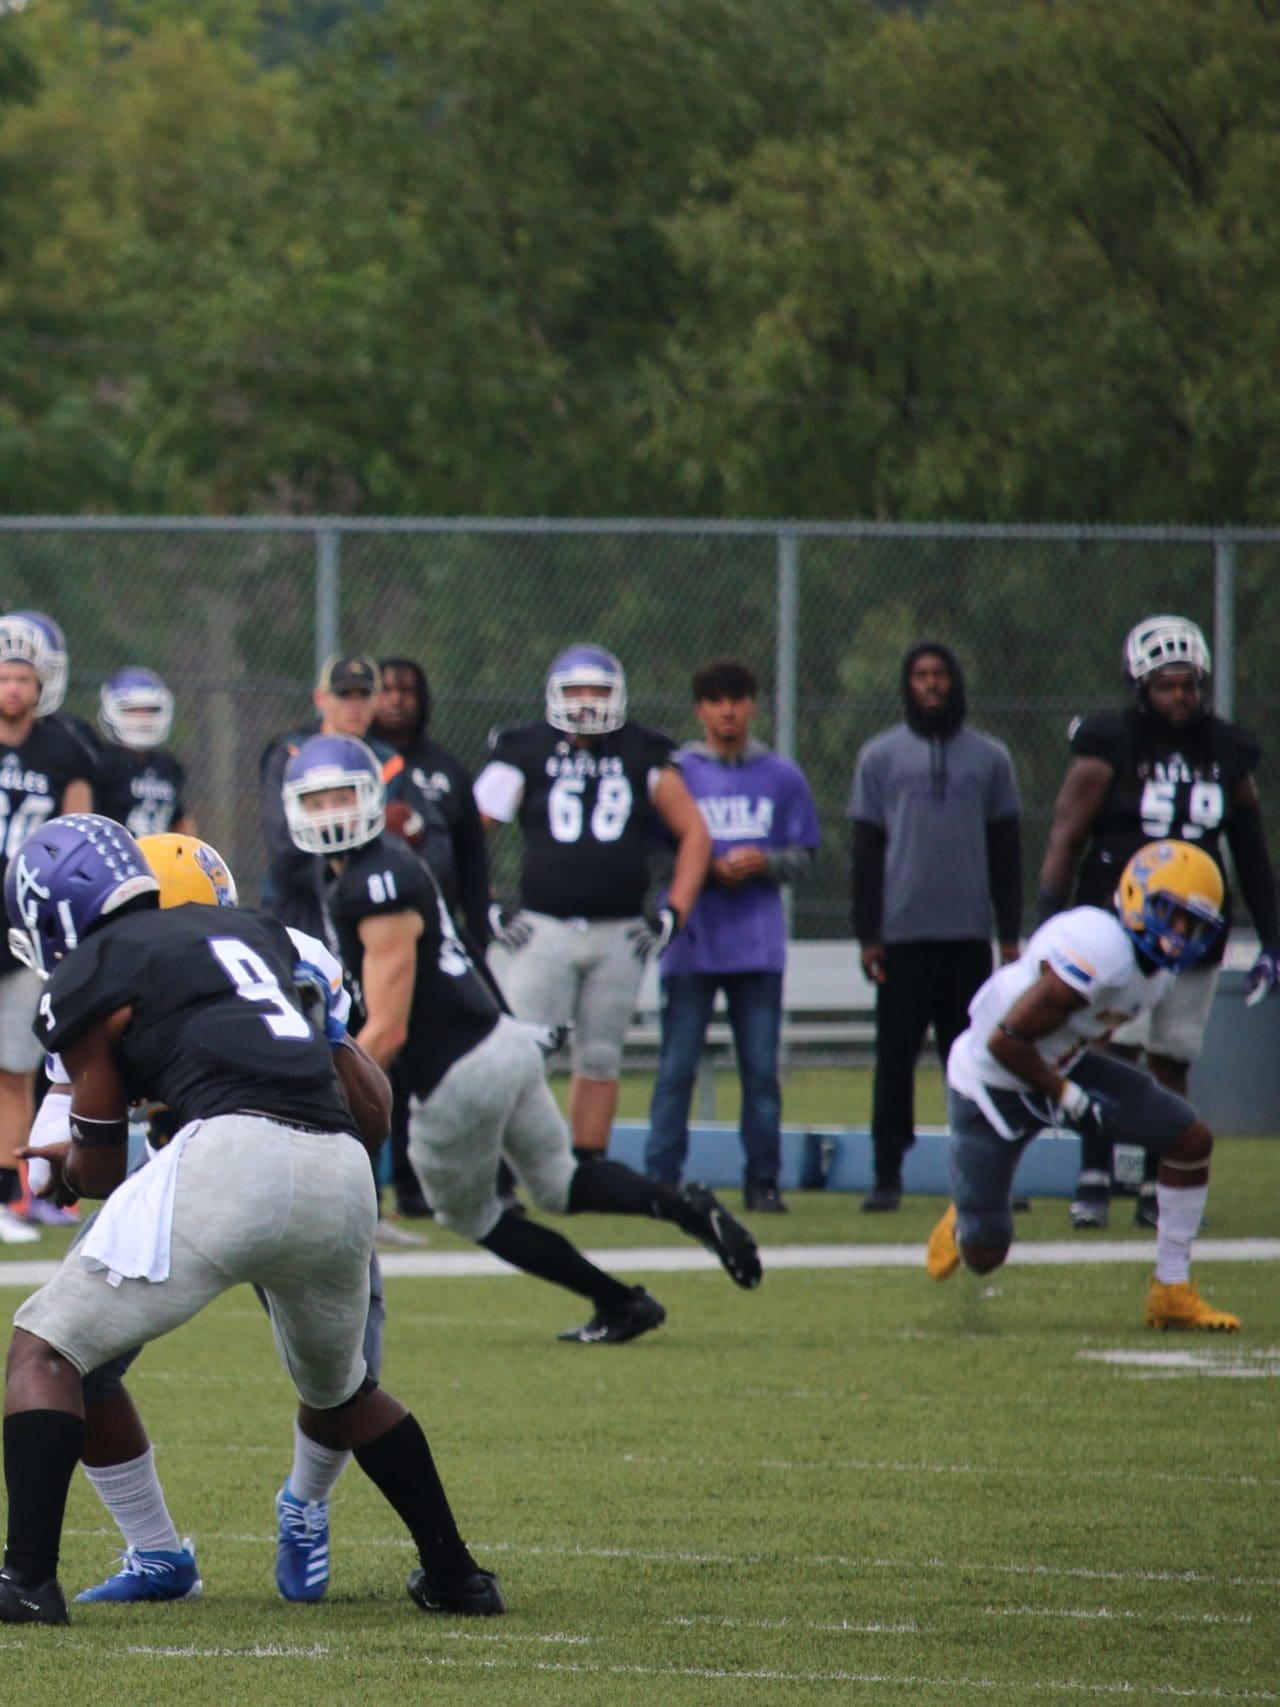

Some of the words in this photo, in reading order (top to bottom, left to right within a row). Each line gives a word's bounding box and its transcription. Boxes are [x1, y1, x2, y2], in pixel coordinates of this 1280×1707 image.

[549, 775, 632, 842] 68
[1141, 780, 1224, 839] 59
[368, 870, 397, 904] 81
[39, 992, 56, 1031] 9
[206, 934, 314, 1041] 9
